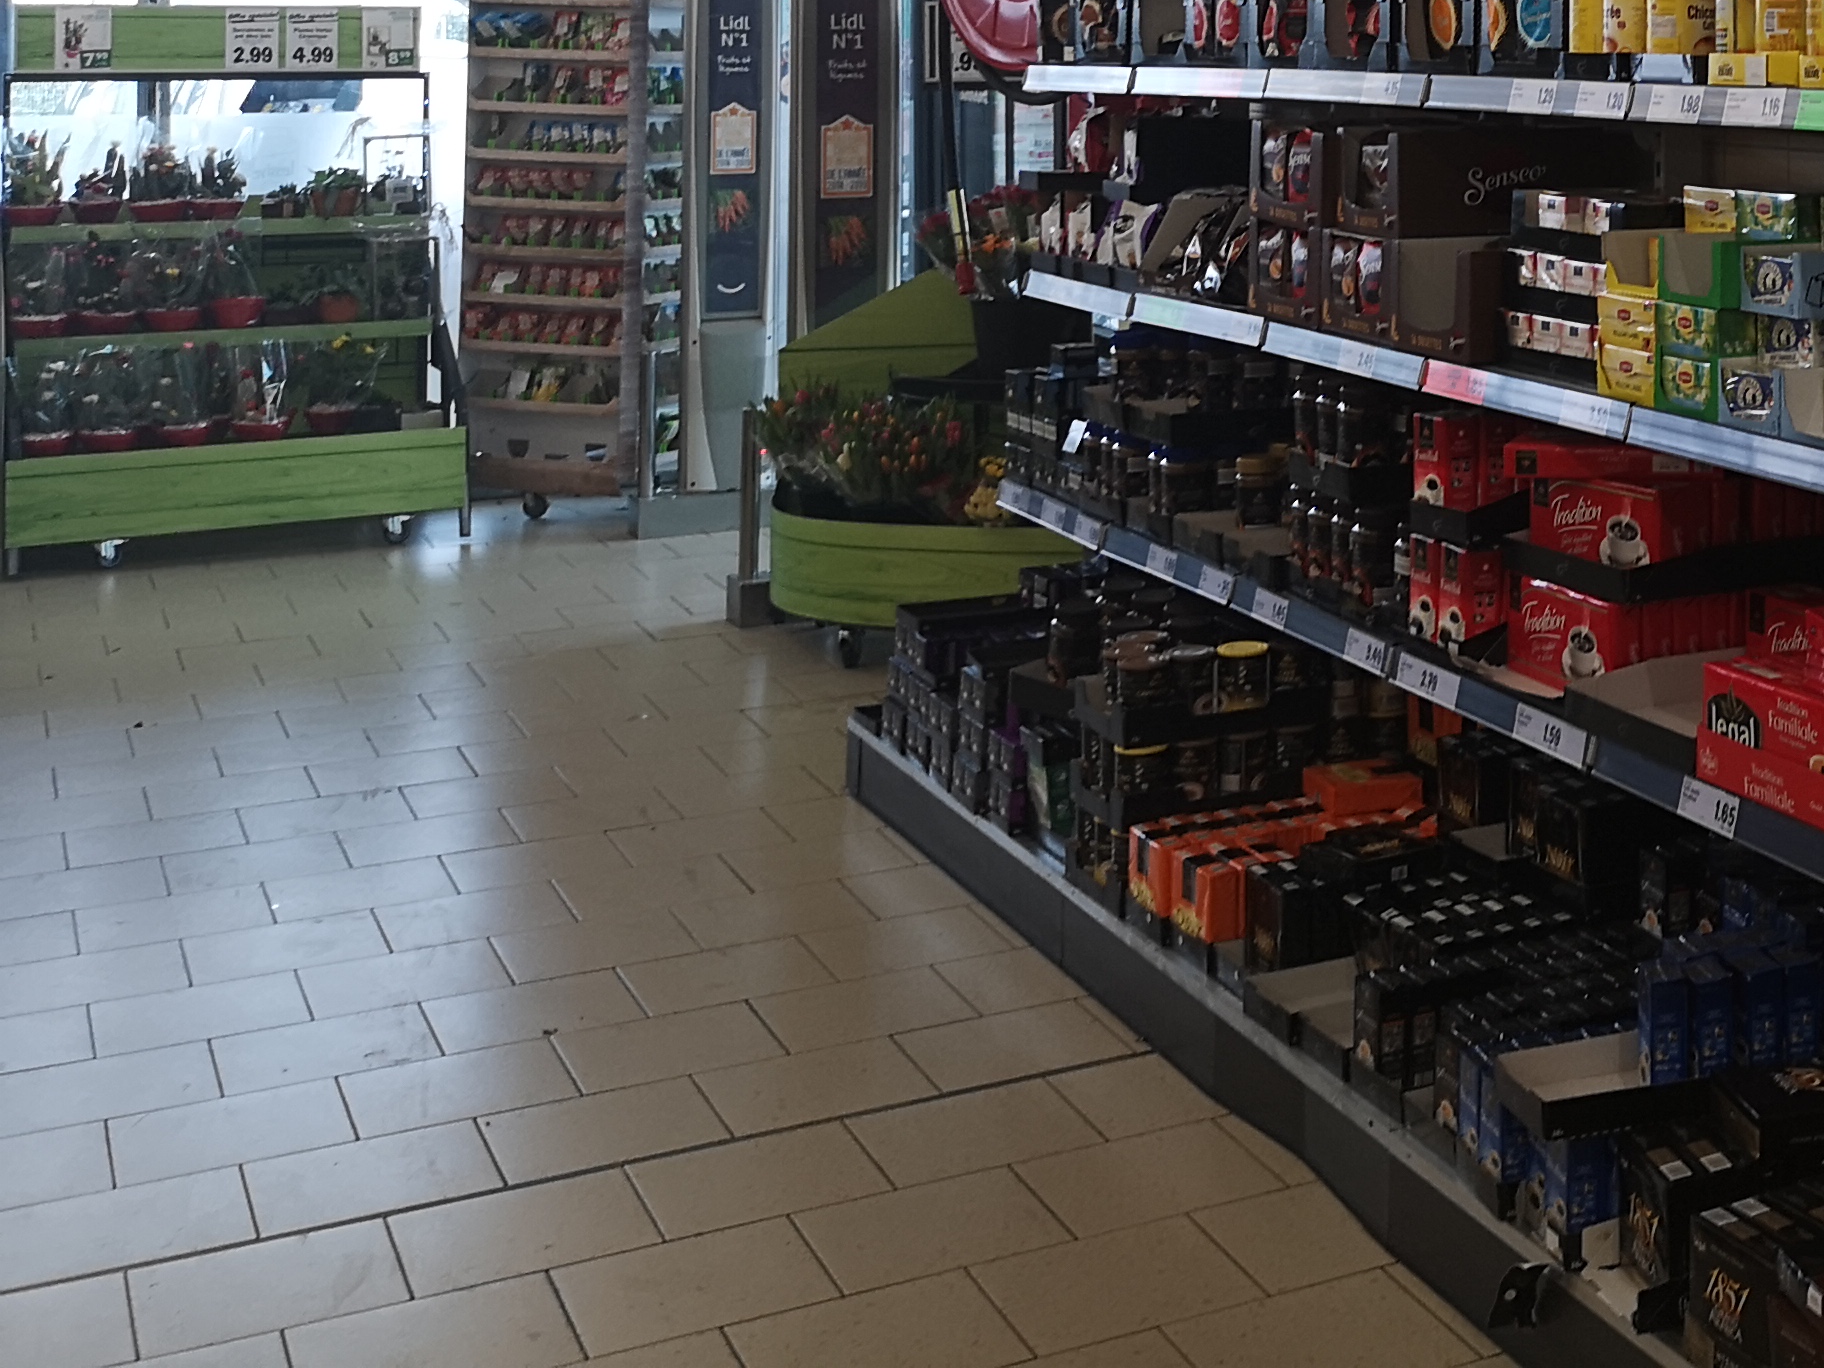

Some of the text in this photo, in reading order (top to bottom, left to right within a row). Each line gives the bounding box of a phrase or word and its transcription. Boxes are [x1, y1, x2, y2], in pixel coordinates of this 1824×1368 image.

[719, 15, 751, 31] Lidl
[830, 13, 866, 30] Lidl
[233, 46, 274, 64] 2.99
[292, 46, 334, 64] 4.99
[1761, 96, 1779, 117] 1.16
[1463, 163, 1547, 206] Senseo
[1551, 493, 1602, 528] Tradition
[1522, 600, 1566, 633] Tradition
[1777, 695, 1809, 719] Tradition
[1768, 709, 1818, 744] Familiale
[1702, 1266, 1752, 1314] 1851
